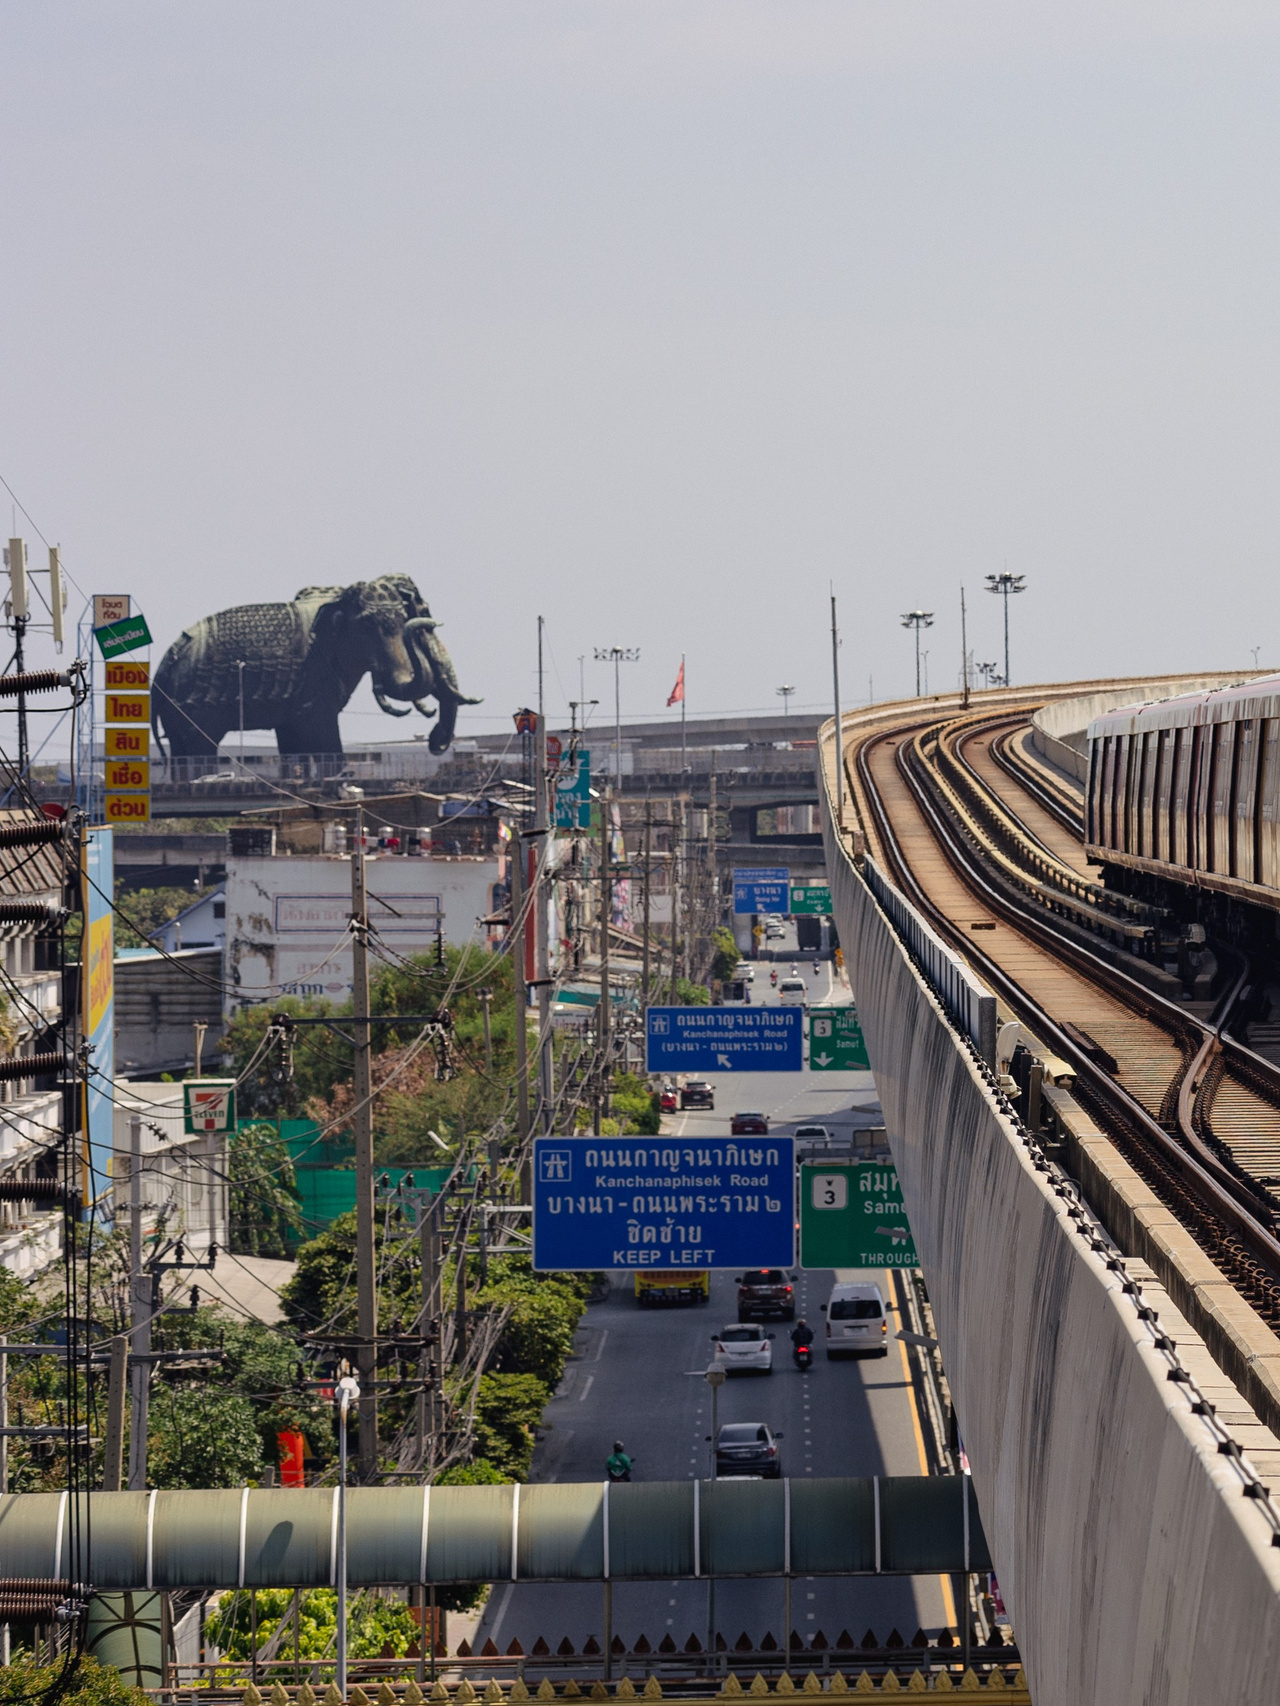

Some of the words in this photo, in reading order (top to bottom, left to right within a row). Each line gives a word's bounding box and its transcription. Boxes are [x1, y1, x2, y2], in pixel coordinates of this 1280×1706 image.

[106, 665, 149, 684] เมือง
[110, 696, 142, 717] ไทย
[115, 732, 140, 750] สิน
[112, 762, 143, 785] เชื่อ
[109, 797, 146, 817] ด่วน
[677, 1011, 794, 1030] ถนนกาญจนาภิเษก
[683, 1029, 759, 1039] Kanchanaphisek
[764, 1029, 788, 1038] Road
[819, 1026, 827, 1035] 3
[585, 1143, 779, 1173] ถนนกาญจนาภิเษก
[595, 1174, 721, 1190] Kanchanaphisek
[730, 1174, 769, 1187] Road
[823, 1190, 836, 1205] 3
[626, 1217, 702, 1243] ชิดซ้าย
[613, 1249, 661, 1264] KEEP
[670, 1249, 715, 1264] LEFT
